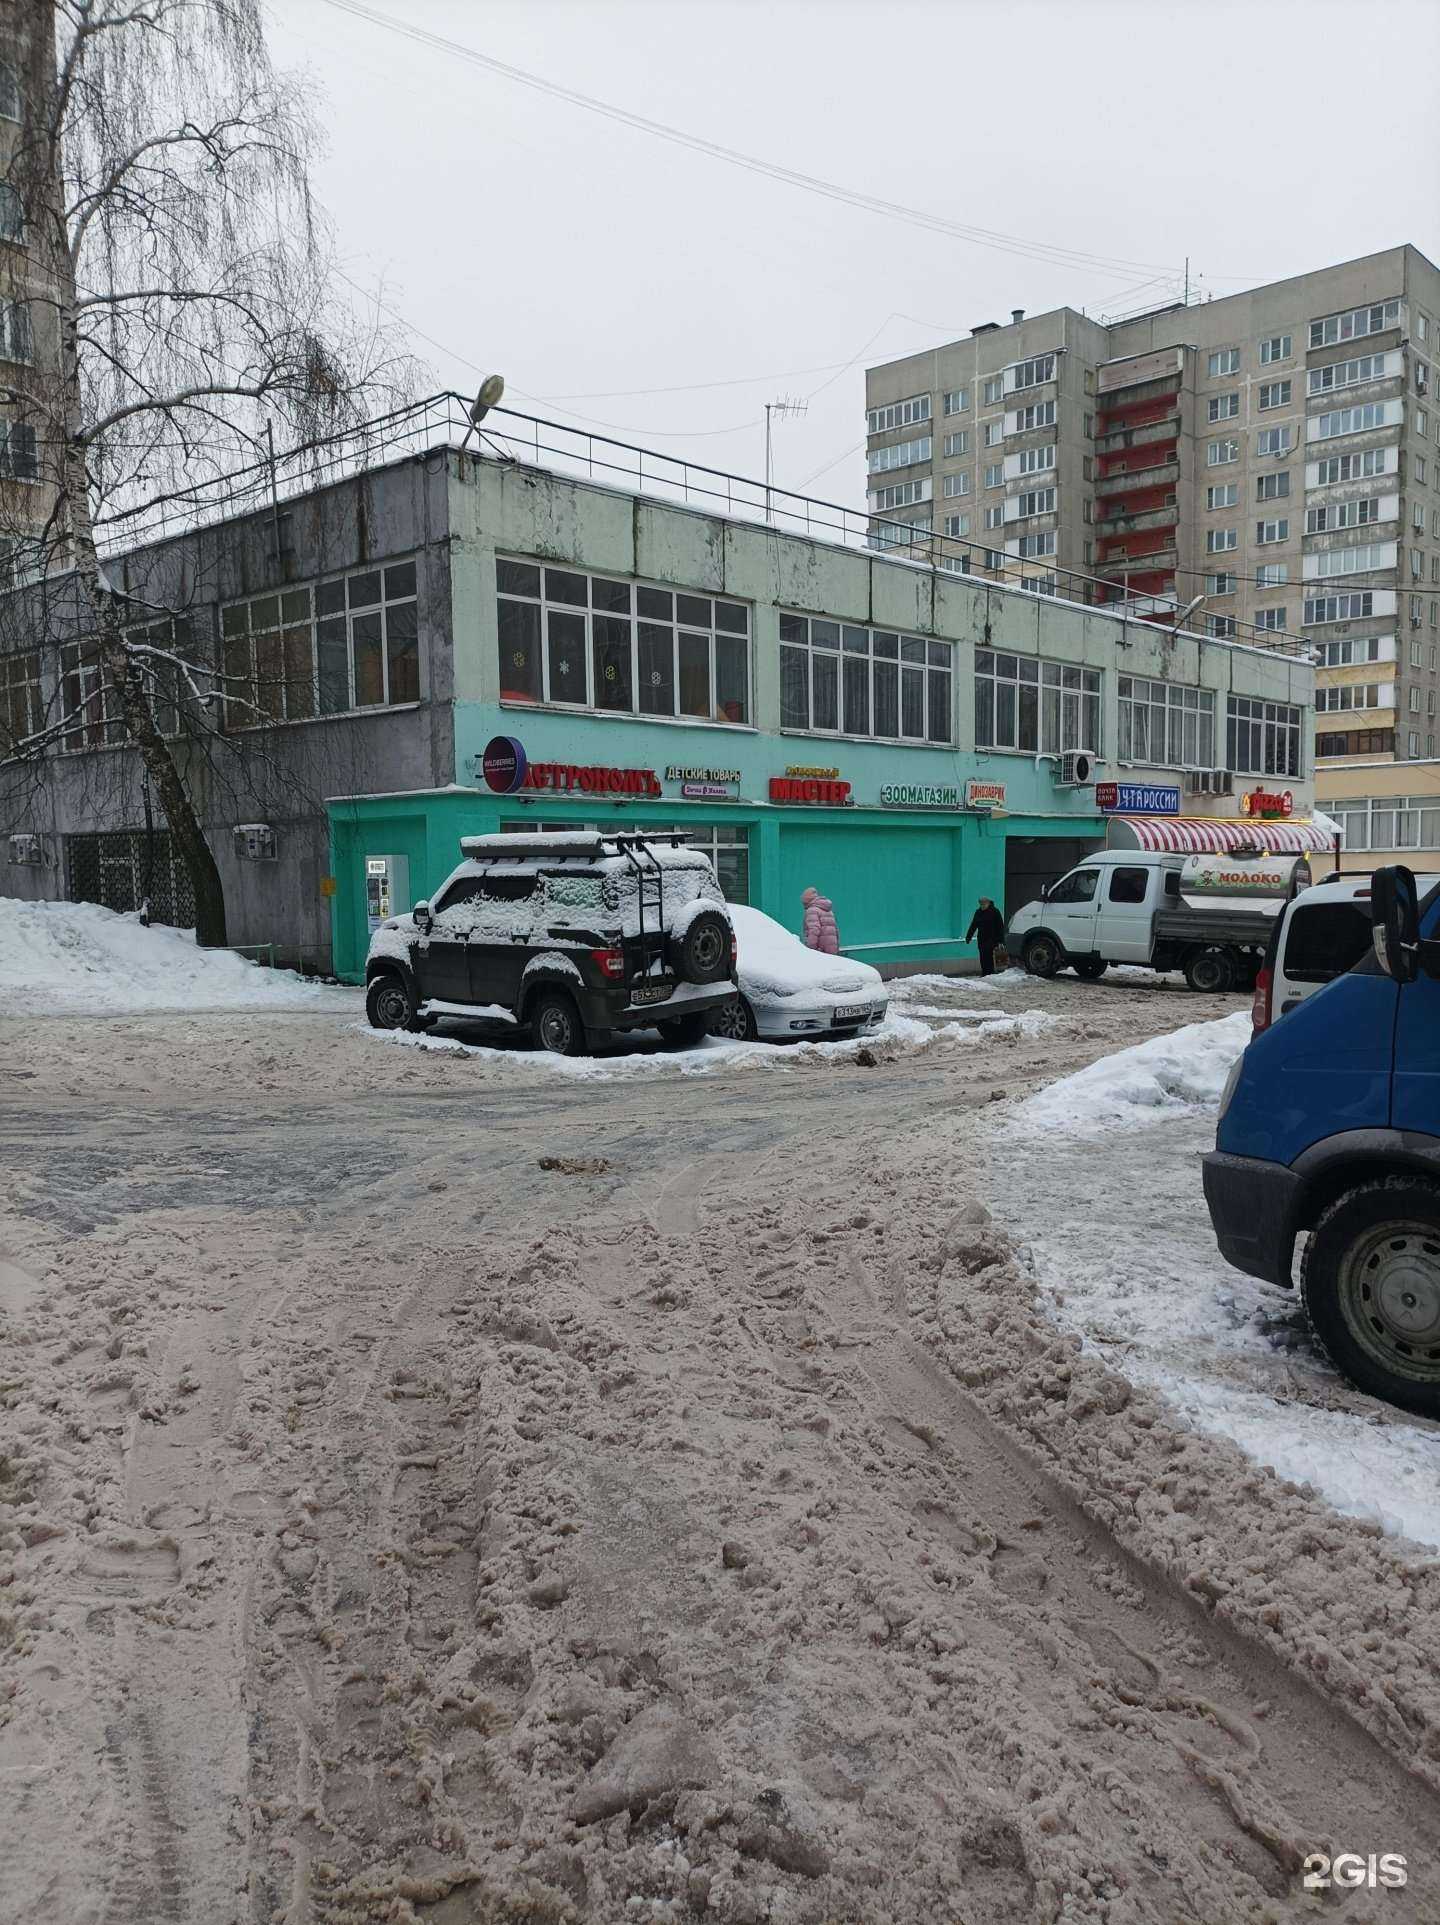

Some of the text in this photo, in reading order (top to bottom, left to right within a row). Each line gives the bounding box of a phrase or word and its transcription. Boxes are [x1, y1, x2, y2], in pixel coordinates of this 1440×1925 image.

[523, 761, 661, 797] АСТРОНОМЪ
[667, 767, 708, 781] ДЕТСКИЕ
[769, 778, 851, 802] МАСТЕР
[886, 785, 957, 805] ЗООМАГАЗИН
[1117, 788, 1177, 810] ЧТА РОССИИ
[1219, 871, 1281, 884] МОЛОКО
